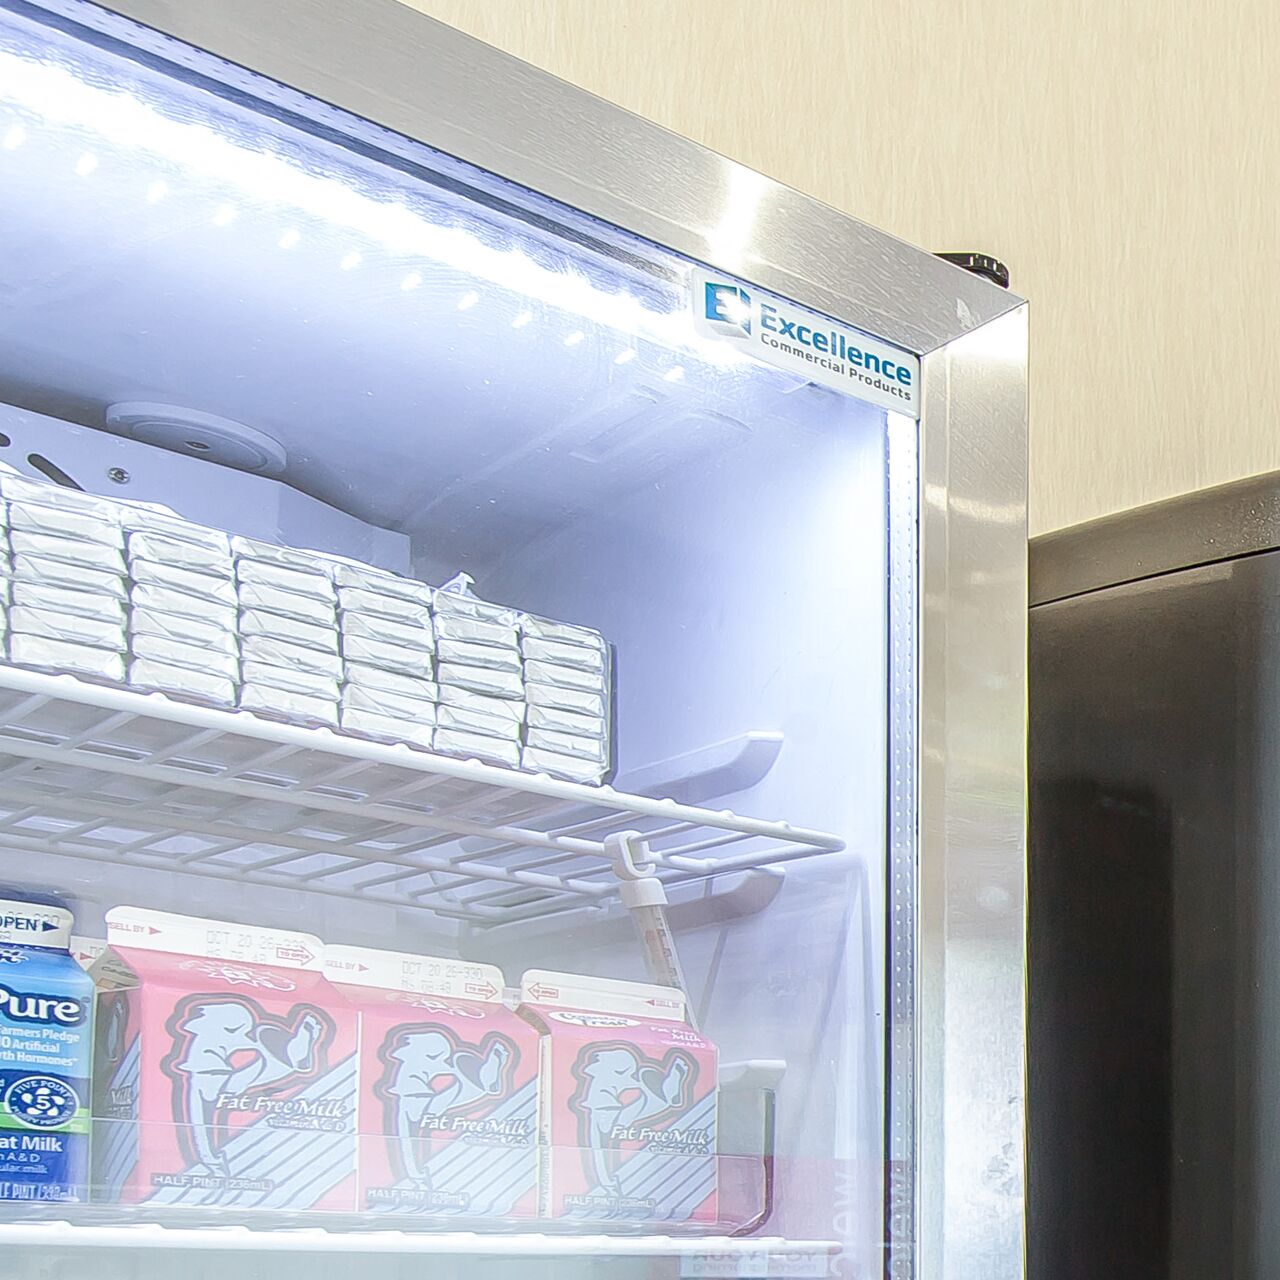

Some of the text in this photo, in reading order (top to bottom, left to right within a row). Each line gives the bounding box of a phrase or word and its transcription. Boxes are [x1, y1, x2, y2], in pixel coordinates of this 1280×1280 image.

[760, 304, 911, 385] Excellence
[761, 334, 911, 401] Commercial Products
[0, 915, 37, 931] PEN
[42, 1028, 80, 1043] Pledge
[12, 1040, 60, 1053] Artificial
[36, 1095, 51, 1110] 5
[216, 1093, 349, 1118] Fat Free Milk
[420, 1114, 529, 1136] Fat Free Milk
[22, 1135, 63, 1152] Milk
[611, 1125, 708, 1146] Fat Free Milk
[153, 1175, 191, 1187] HALF
[192, 1177, 222, 1189] PINT
